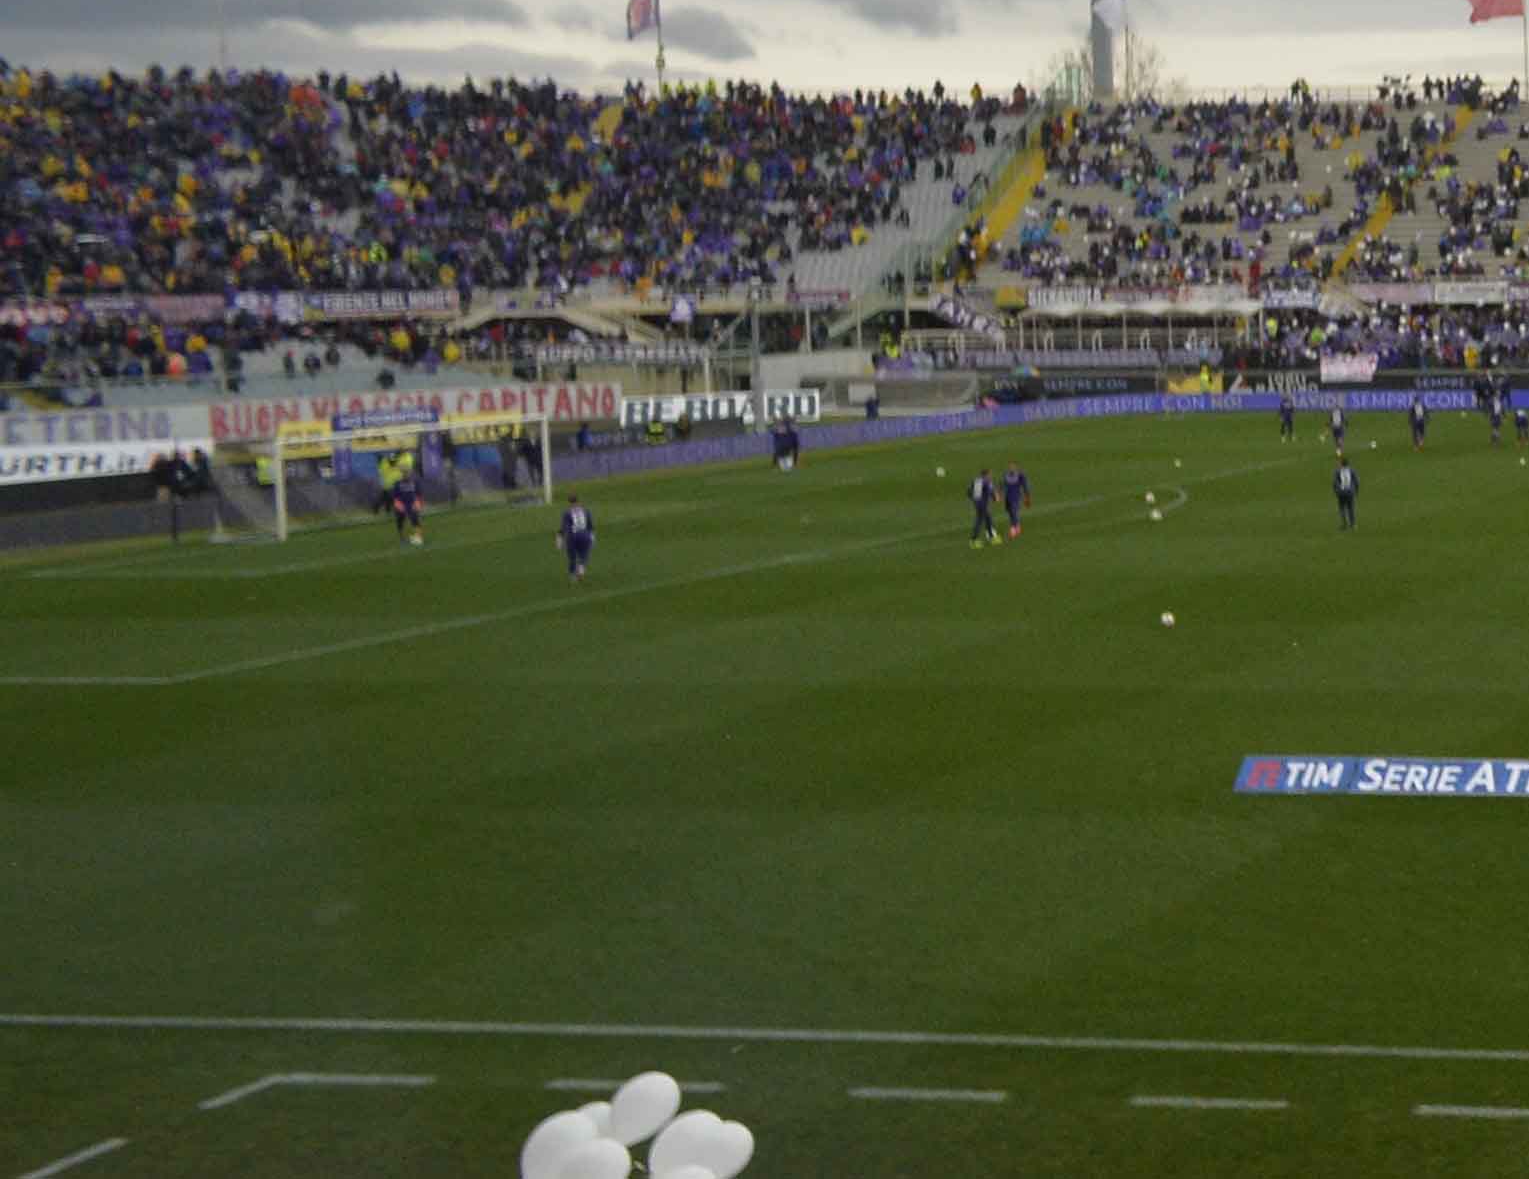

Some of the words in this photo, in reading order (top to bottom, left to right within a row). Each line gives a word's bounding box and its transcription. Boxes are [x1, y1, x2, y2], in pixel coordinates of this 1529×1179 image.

[456, 384, 617, 419] CAPITANO
[4, 408, 172, 444] ETERNO
[1283, 762, 1344, 789] TIM
[1355, 758, 1463, 793] SERIE
